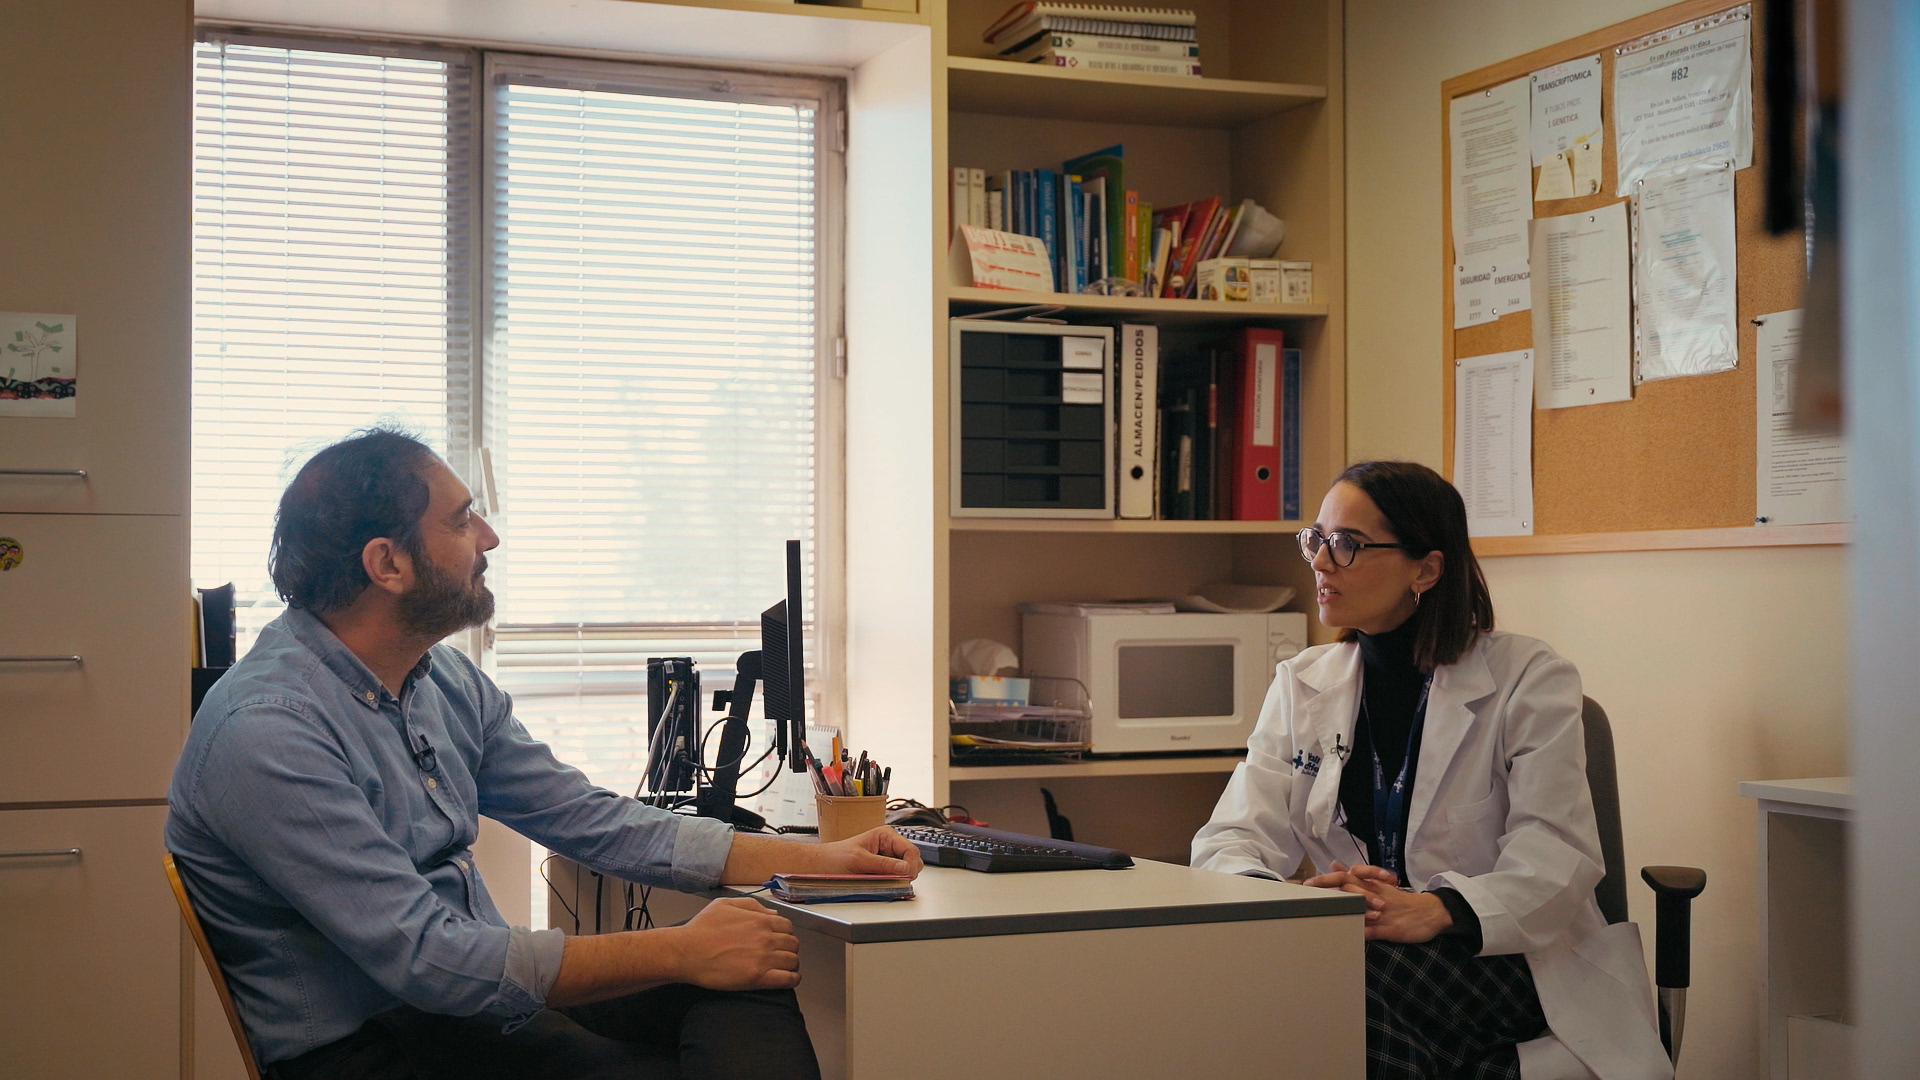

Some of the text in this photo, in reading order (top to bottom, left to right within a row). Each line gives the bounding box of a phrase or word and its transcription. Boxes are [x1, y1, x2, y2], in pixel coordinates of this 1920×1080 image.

[1538, 69, 1592, 93] TRANSCRIPTOMICA
[1671, 66, 1689, 82] #82
[1460, 273, 1491, 286] SEGURIDAD
[1134, 329, 1145, 457] ALMACEN/PEDIDOS
[1307, 752, 1321, 764] Vall
